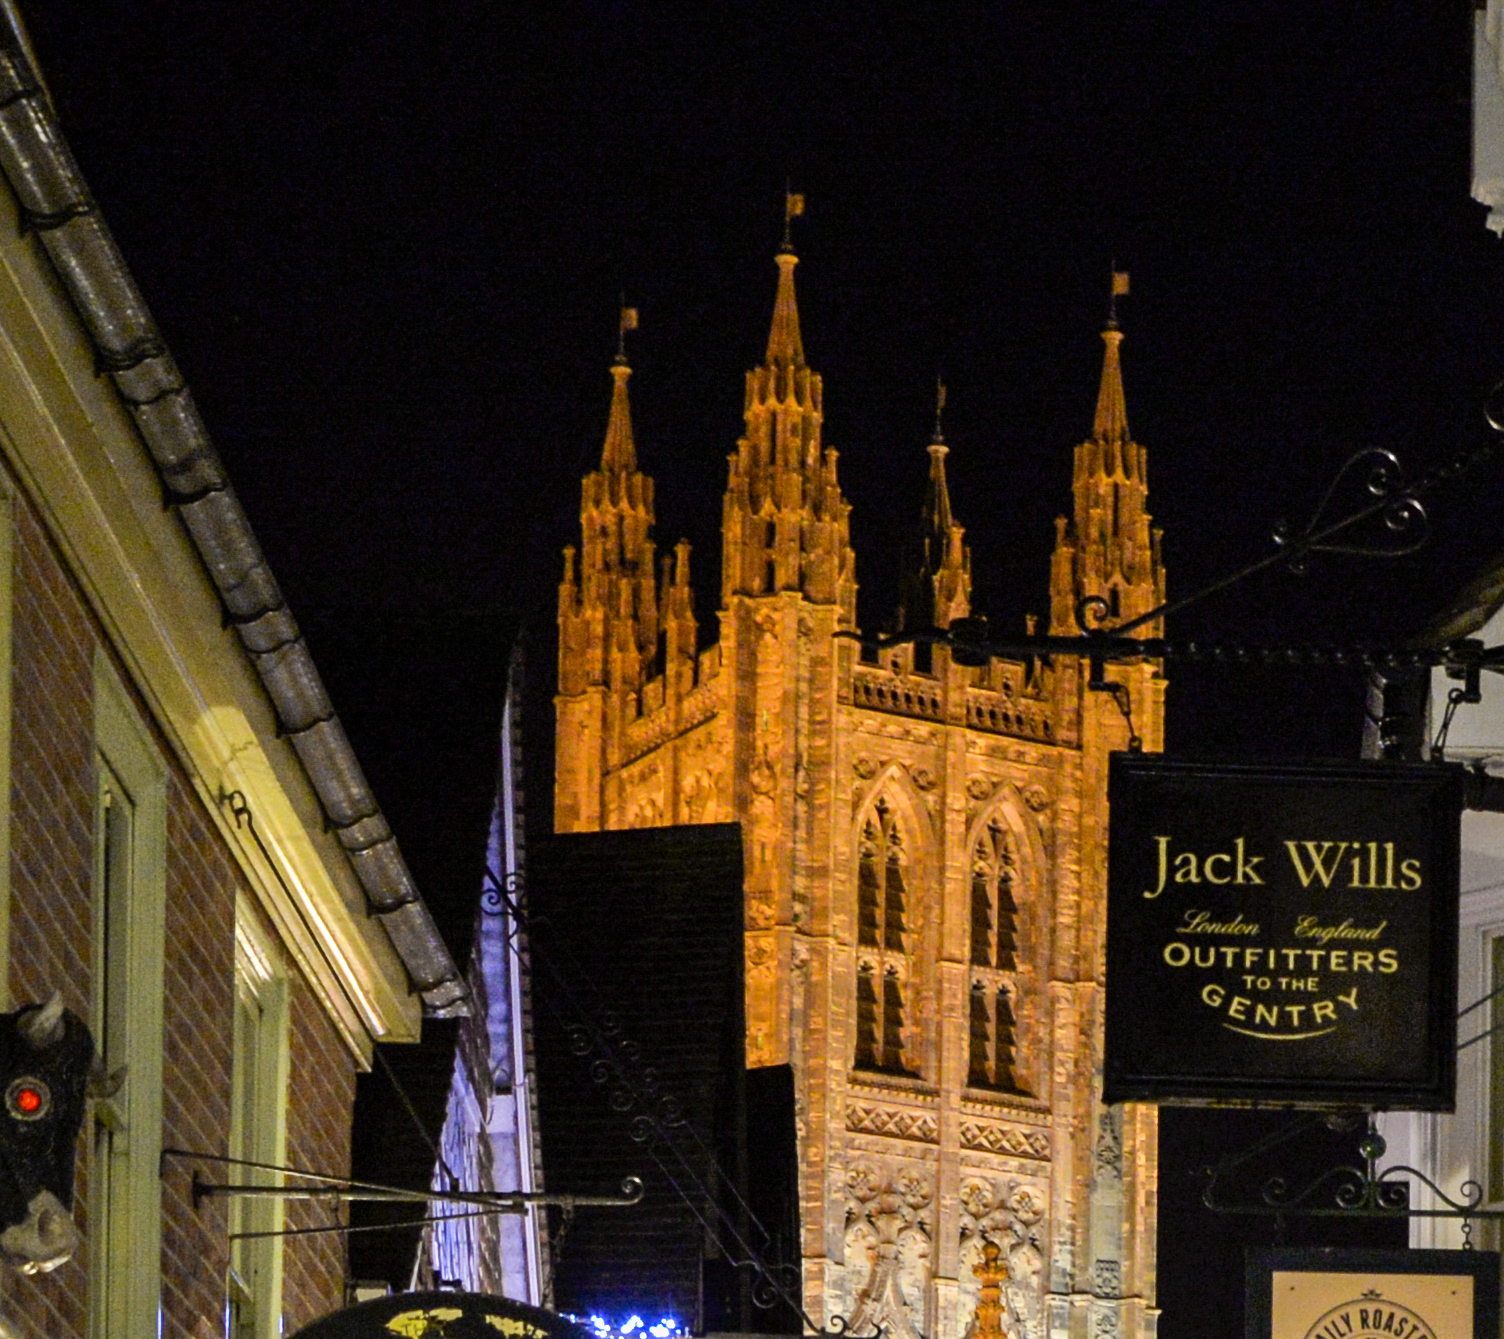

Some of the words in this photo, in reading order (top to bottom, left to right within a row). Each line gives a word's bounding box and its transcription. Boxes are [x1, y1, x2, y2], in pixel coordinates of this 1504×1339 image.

[1143, 836, 1266, 899] Jack
[1284, 840, 1423, 891] Wills
[1176, 909, 1260, 936] London
[1295, 915, 1387, 946] England
[1163, 942, 1399, 974] OUTFITTERS
[1243, 975, 1271, 991] TO
[1278, 976, 1320, 992] THE
[1201, 983, 1359, 1027] GENTRY
